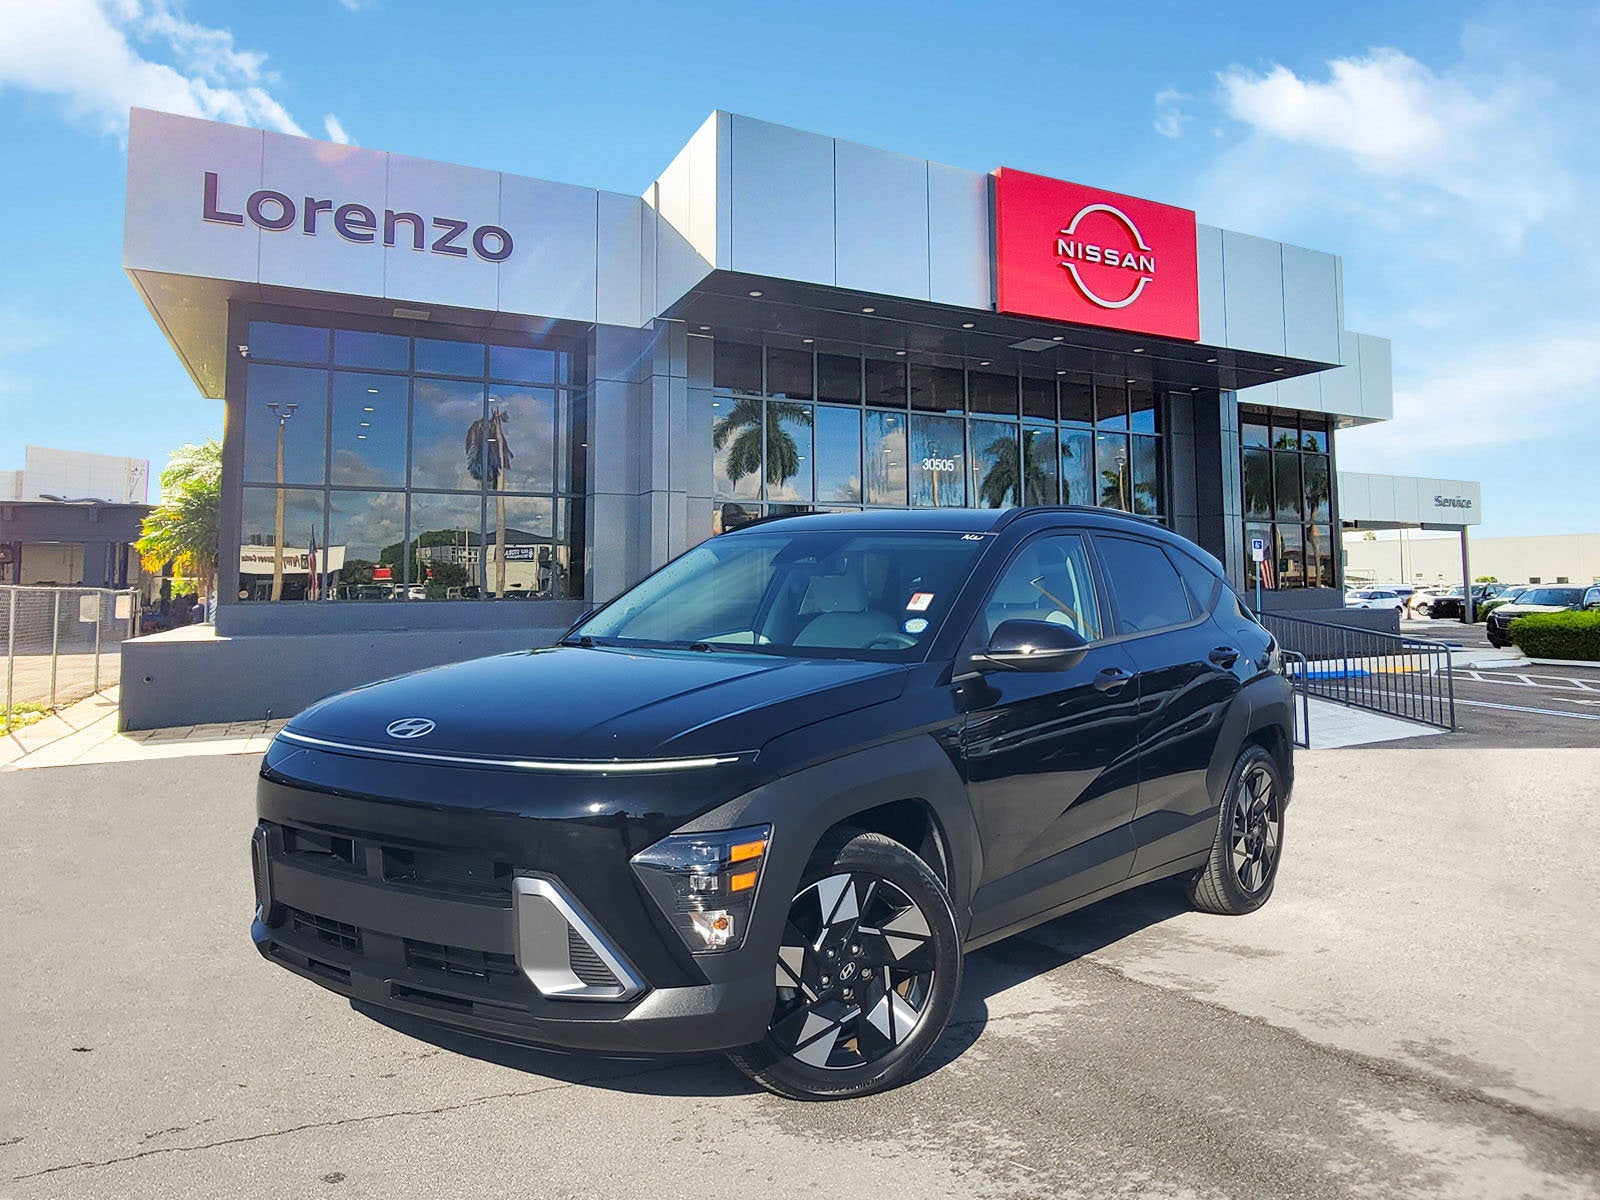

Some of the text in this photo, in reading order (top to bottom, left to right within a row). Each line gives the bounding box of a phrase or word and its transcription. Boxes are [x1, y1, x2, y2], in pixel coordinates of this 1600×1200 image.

[202, 171, 514, 262] Lorenzo
[1057, 238, 1155, 273] NISSAN
[922, 457, 955, 471] 30505
[1434, 495, 1472, 509] Service
